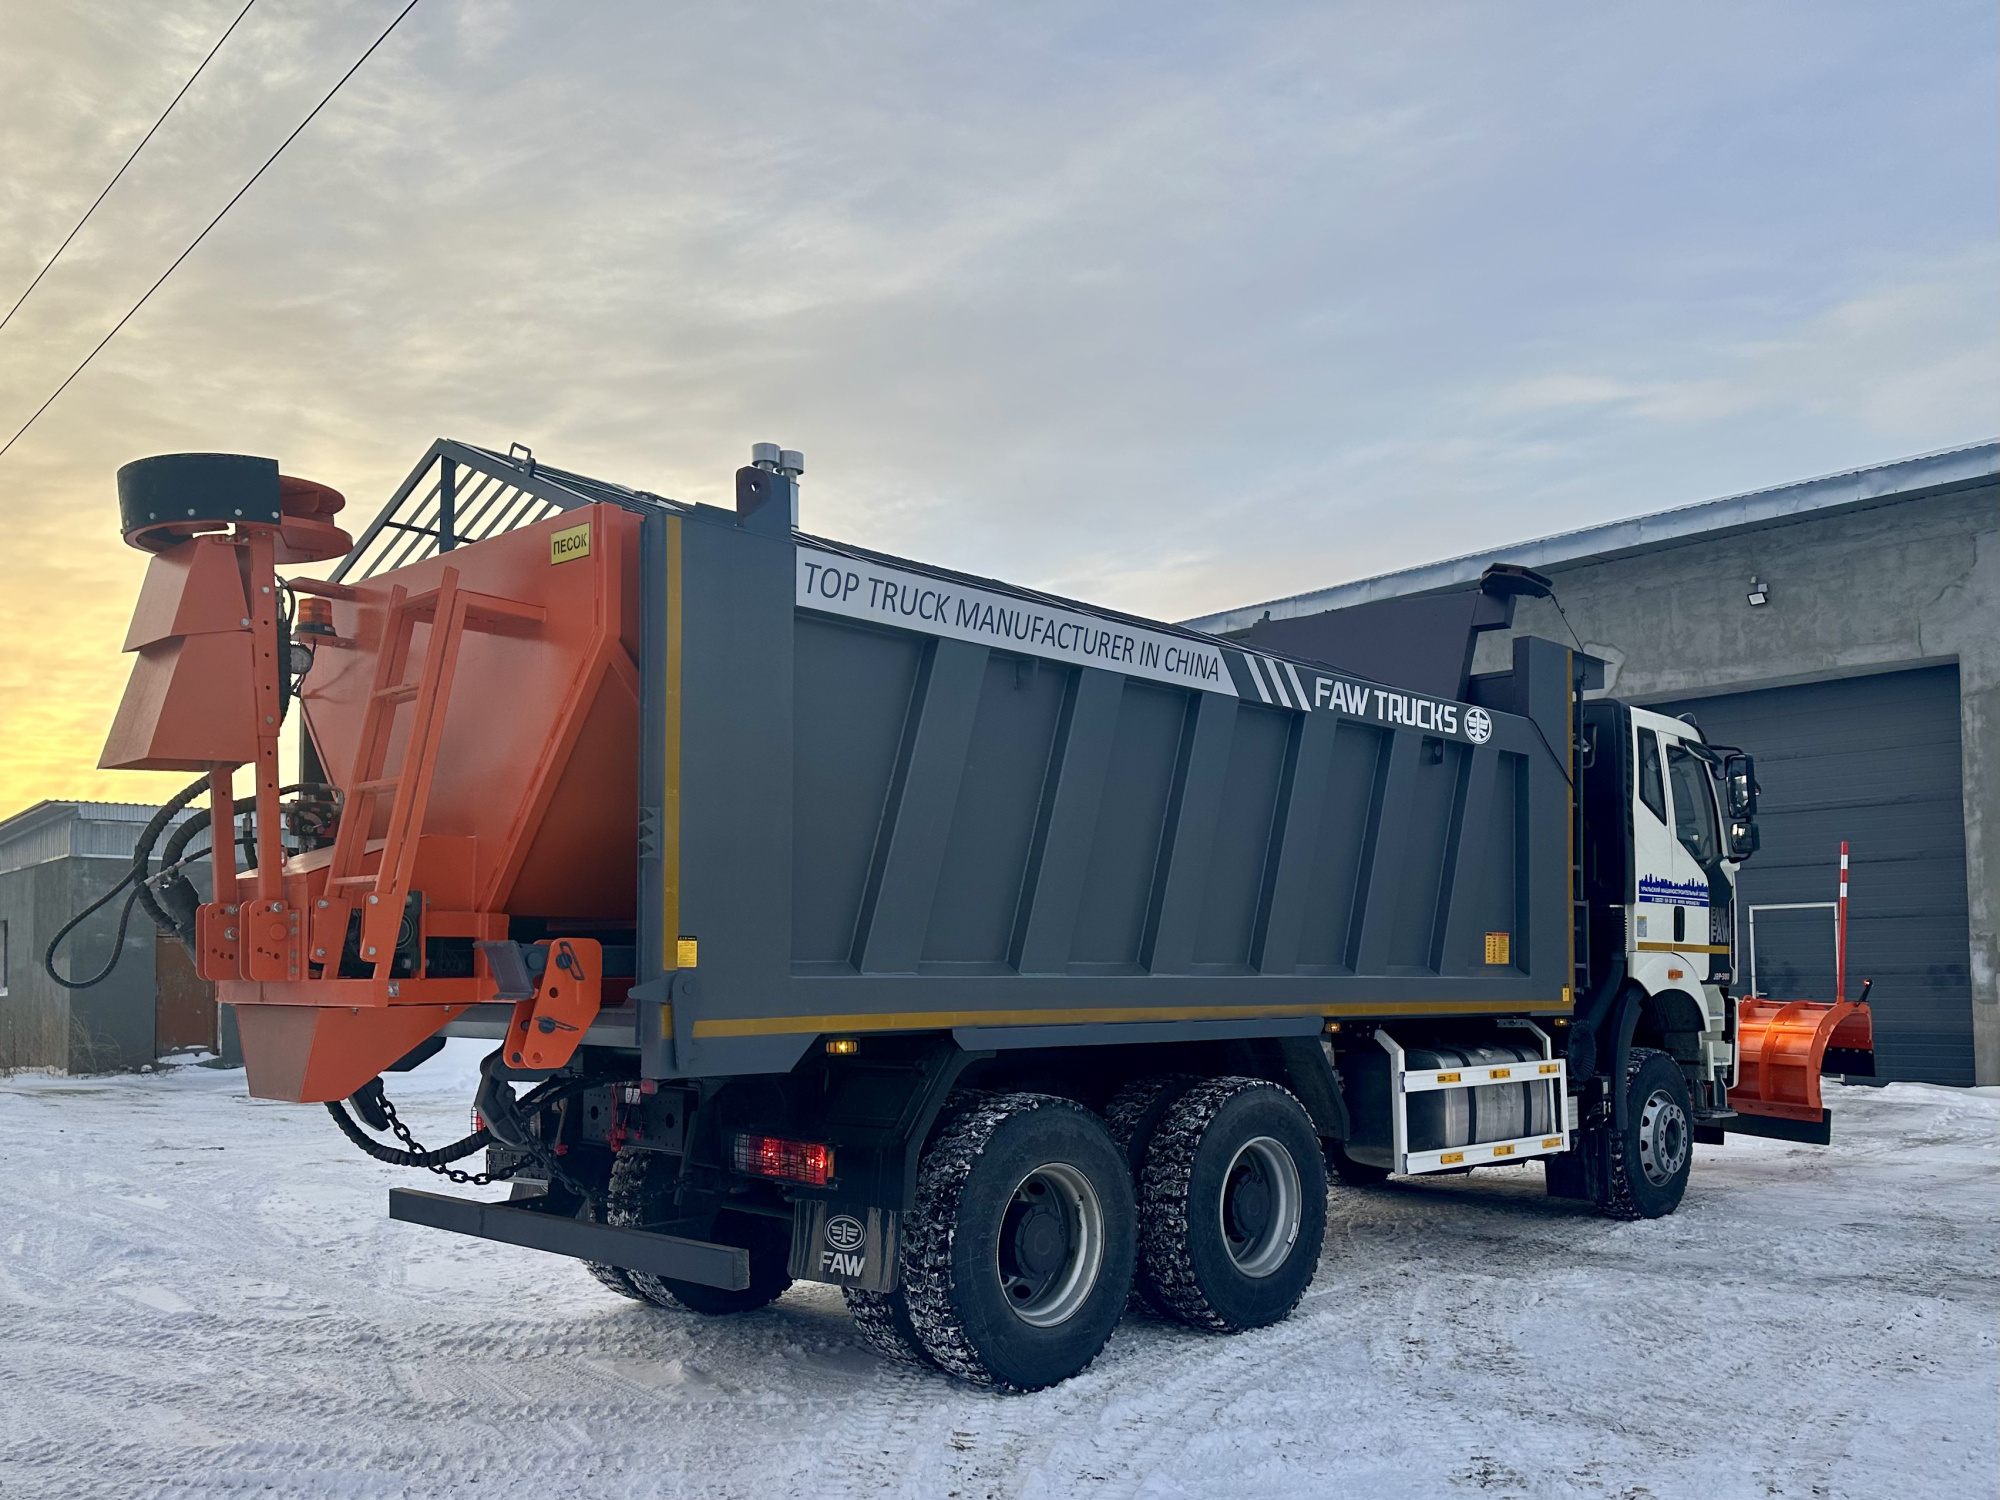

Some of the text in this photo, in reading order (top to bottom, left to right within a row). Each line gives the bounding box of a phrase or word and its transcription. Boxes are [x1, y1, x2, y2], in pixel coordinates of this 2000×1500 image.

[554, 533, 587, 555] ПЕСОК
[804, 562, 1219, 682] TOP TRUCK MANUFACTURER IN CHINA
[1315, 676, 1457, 734] FAW TRUCKS
[818, 1251, 866, 1277] FAW
